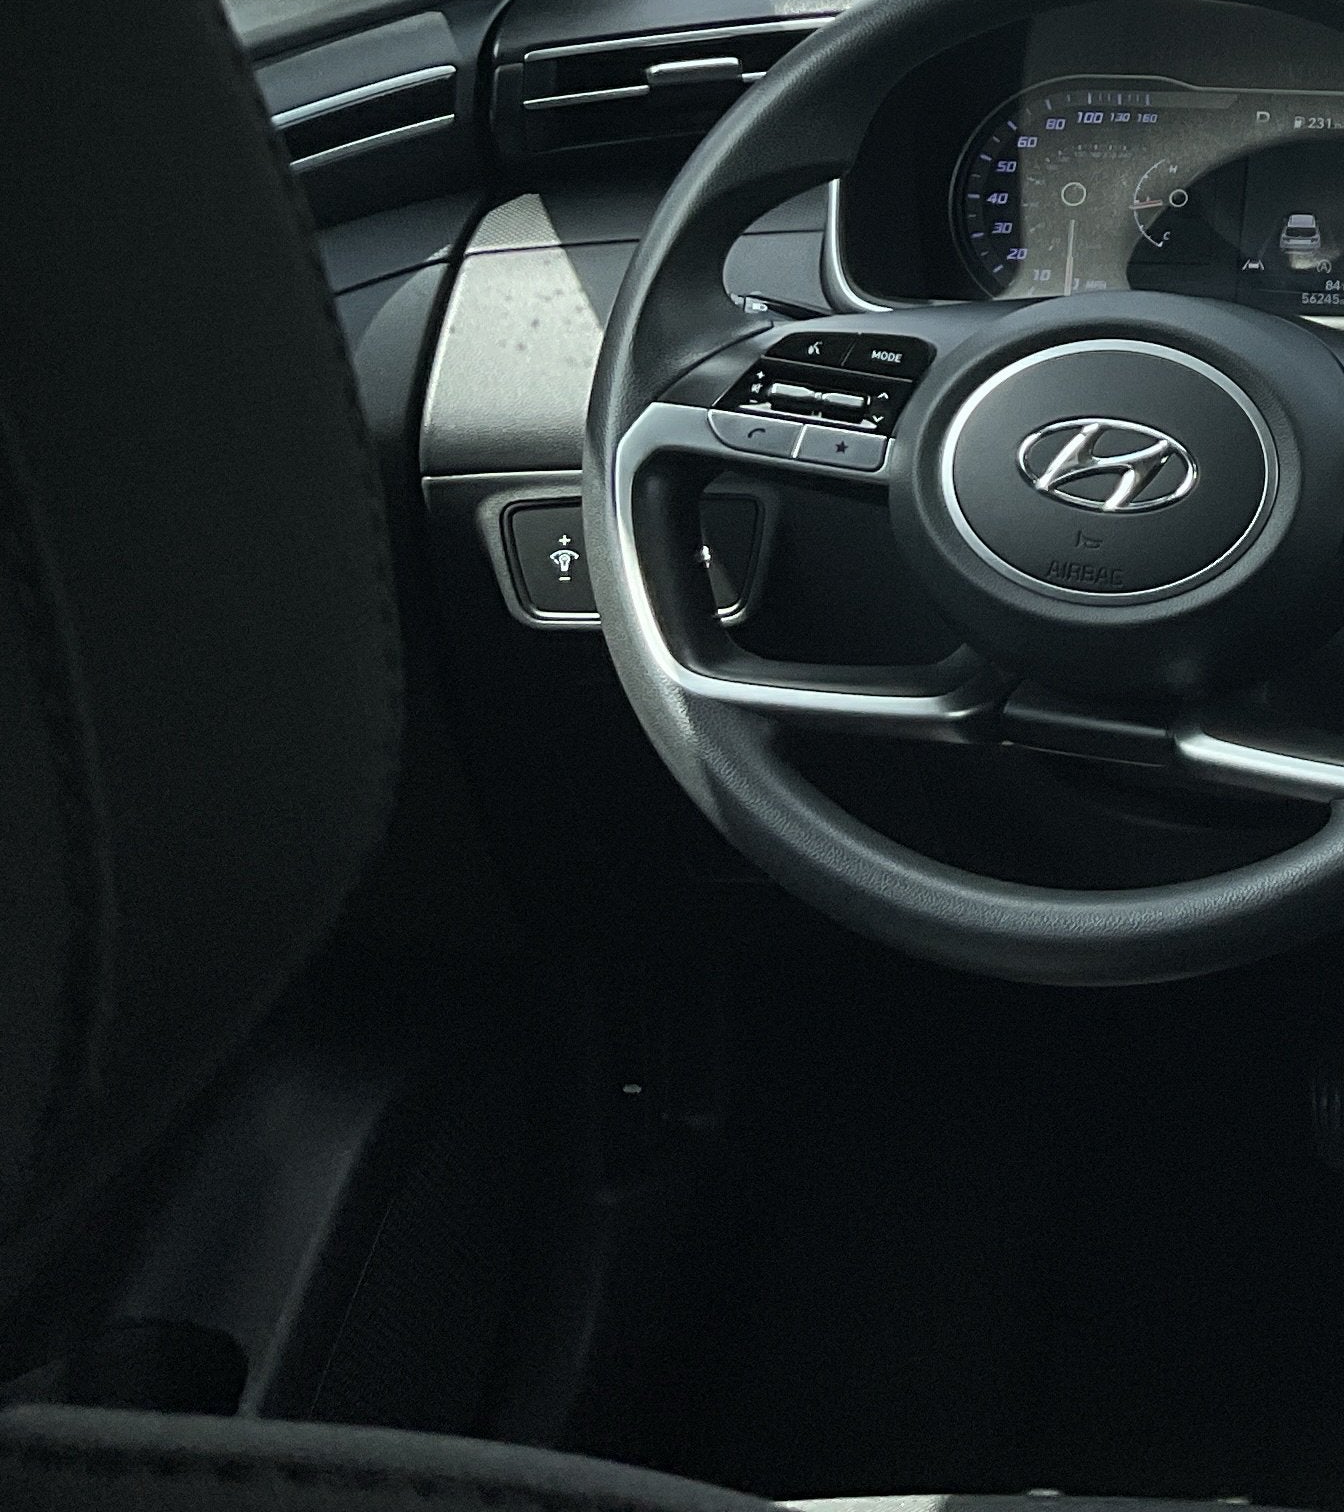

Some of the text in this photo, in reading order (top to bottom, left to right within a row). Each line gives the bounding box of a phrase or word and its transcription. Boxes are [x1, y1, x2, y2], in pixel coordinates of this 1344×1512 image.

[1077, 112, 1104, 124] 100
[1110, 112, 1131, 123] 130
[1137, 113, 1158, 124] 160
[1255, 111, 1271, 124] D
[1045, 118, 1066, 131] 80
[1017, 136, 1038, 149] 60
[996, 160, 1017, 173] 50
[1168, 164, 1178, 174] H
[986, 192, 1009, 205] 40
[991, 222, 1013, 234] 30
[1162, 231, 1171, 241] C
[1006, 248, 1028, 260] 20
[1032, 268, 1051, 281] 10
[871, 349, 903, 364] MODE
